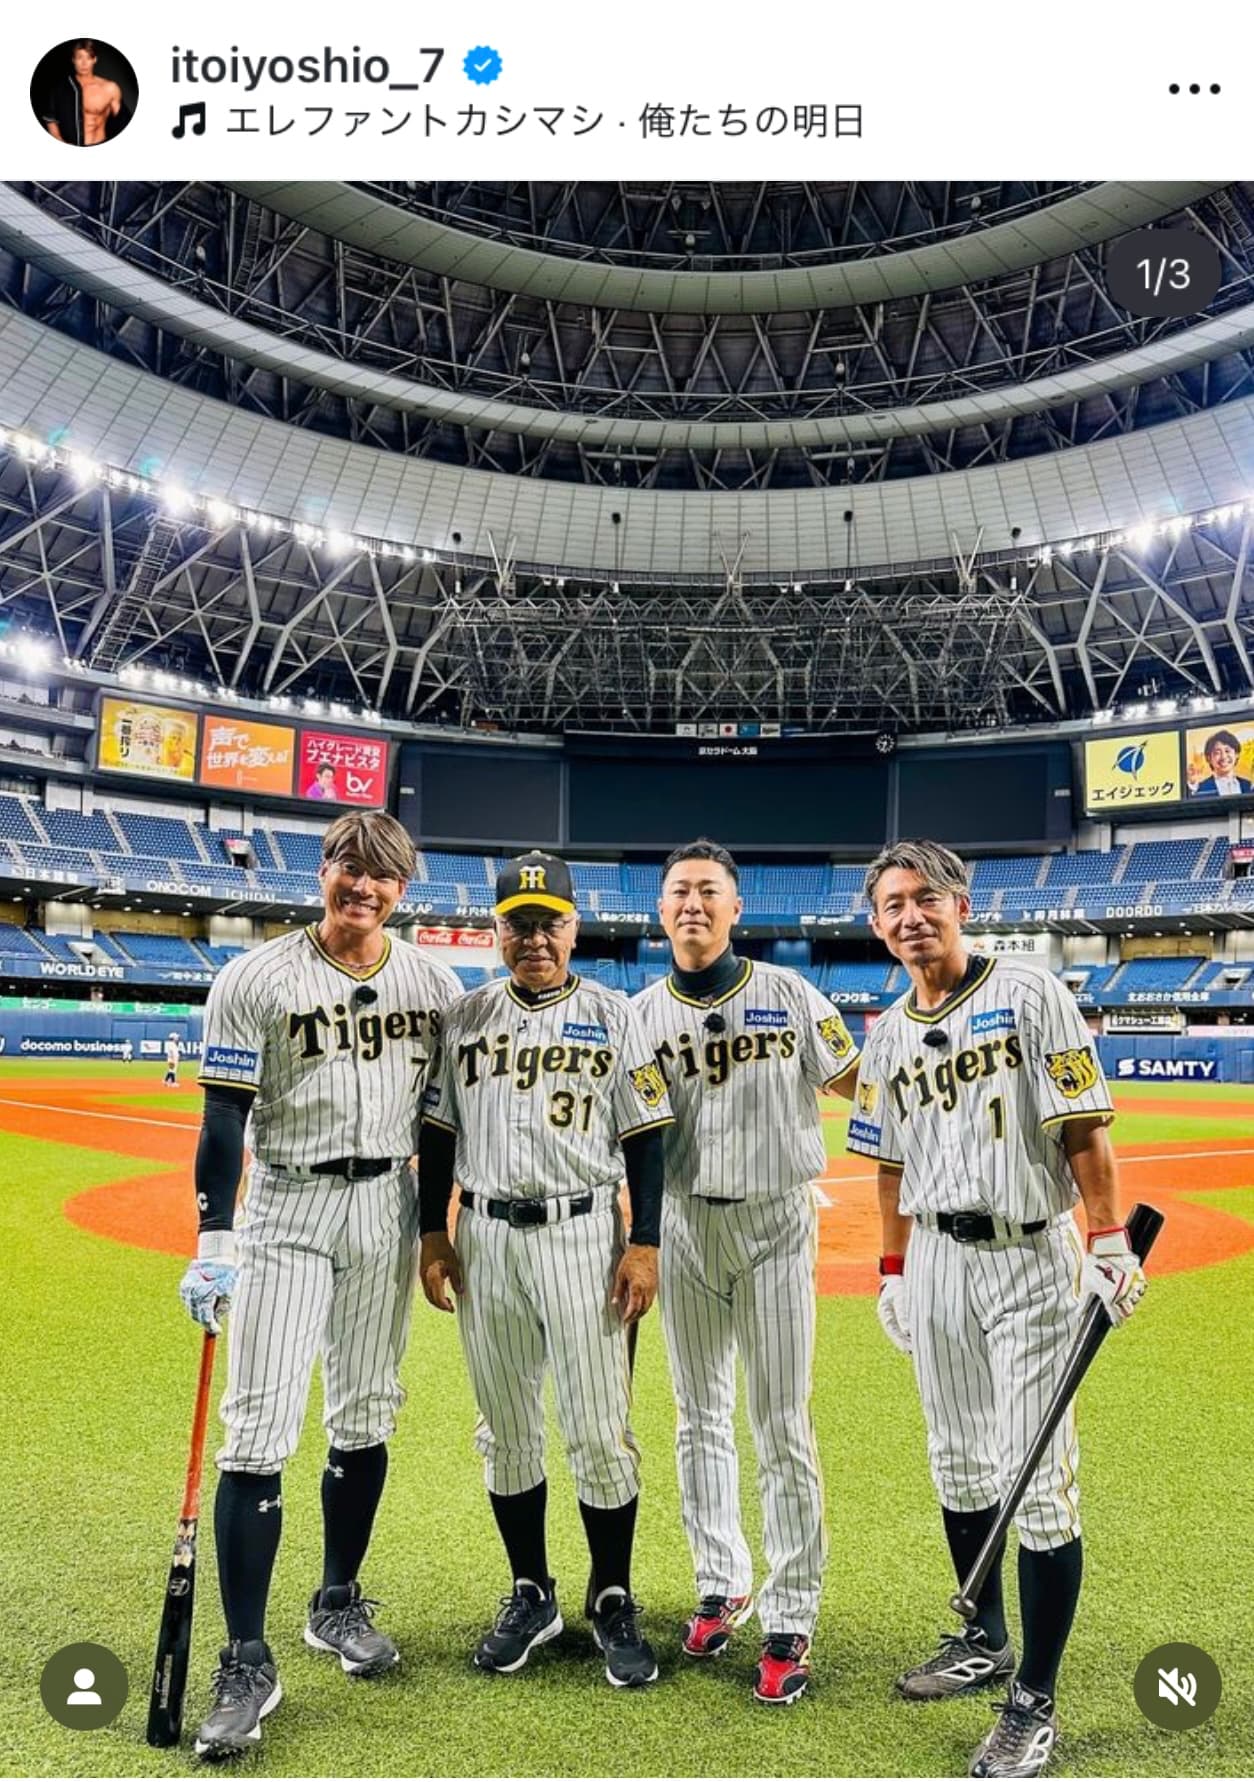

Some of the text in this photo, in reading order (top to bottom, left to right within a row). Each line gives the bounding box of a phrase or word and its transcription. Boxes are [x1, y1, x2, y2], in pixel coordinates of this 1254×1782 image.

[1092, 781, 1175, 801] エイジェック
[147, 880, 211, 896] ONOCOM
[994, 938, 1035, 952] 森本組
[41, 962, 125, 979] WORLD EYE
[746, 1013, 788, 1024] Joshin
[289, 1002, 442, 1061] Tigers
[563, 1025, 607, 1042] Joshin
[20, 1039, 73, 1052] docomo
[208, 1050, 255, 1067] Joshin
[458, 1033, 613, 1090] Tigers
[1139, 1061, 1214, 1077] SAMTY
[550, 1090, 594, 1132] 31
[988, 1096, 1003, 1139] 1
